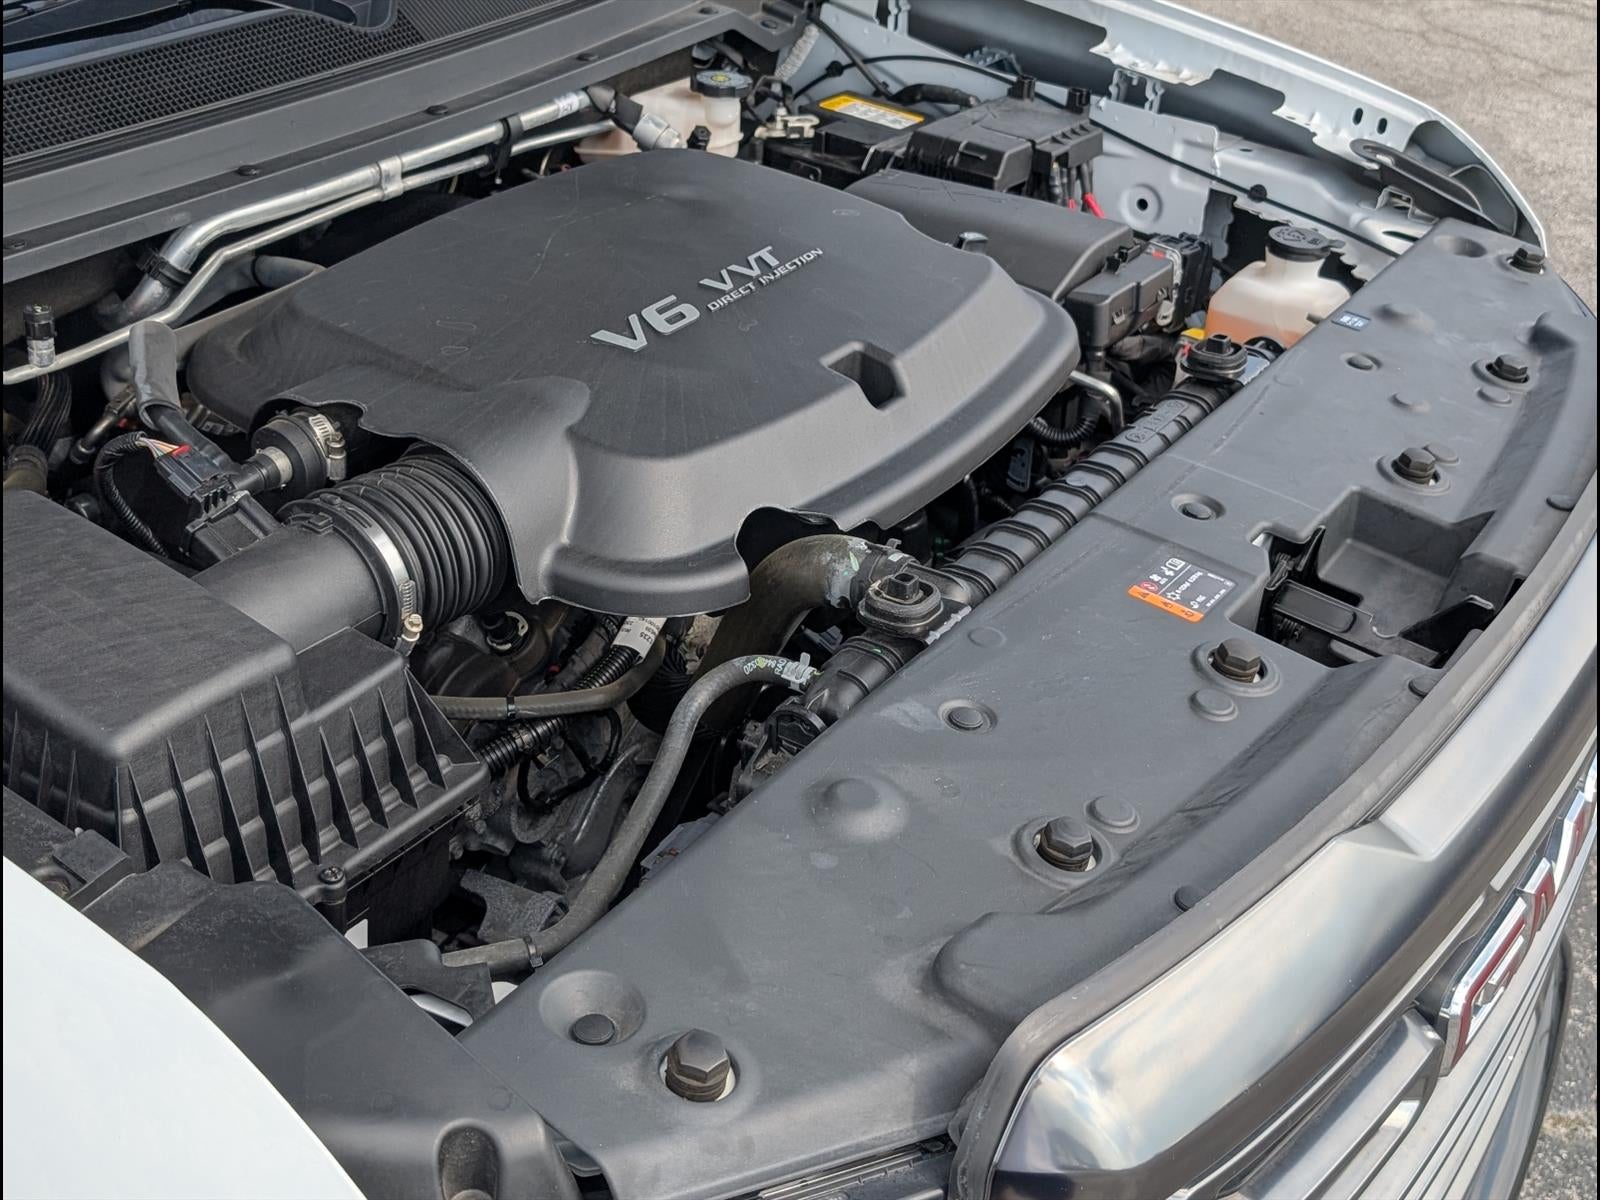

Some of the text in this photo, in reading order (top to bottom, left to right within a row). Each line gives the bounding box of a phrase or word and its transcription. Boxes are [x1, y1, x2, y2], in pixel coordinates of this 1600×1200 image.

[698, 245, 780, 292] VVT
[706, 247, 823, 313] DIRECT INJECTION
[589, 294, 701, 352] V6
